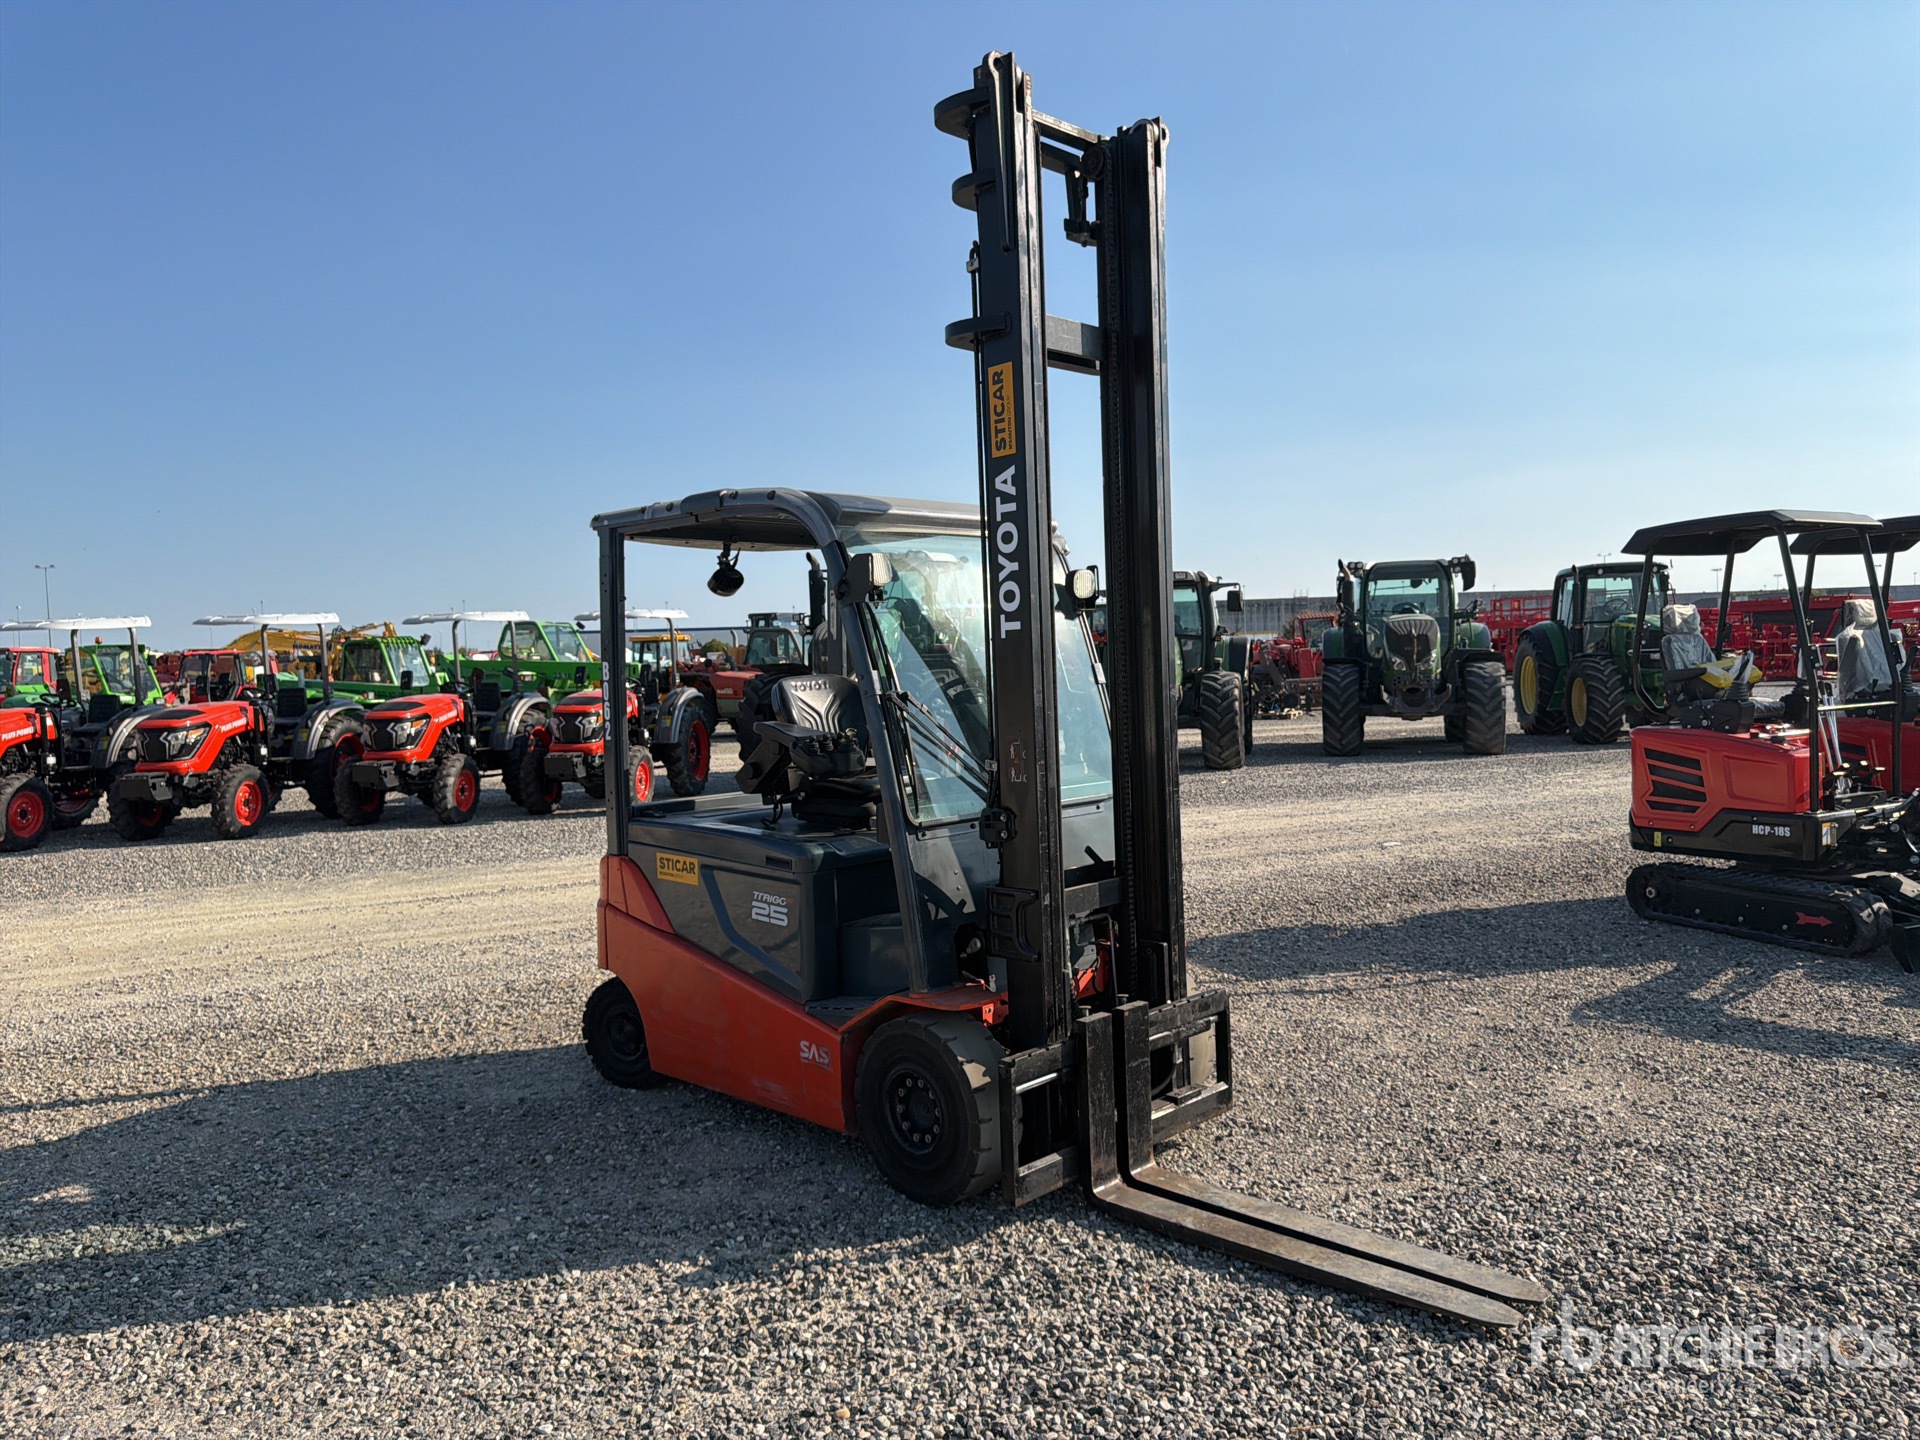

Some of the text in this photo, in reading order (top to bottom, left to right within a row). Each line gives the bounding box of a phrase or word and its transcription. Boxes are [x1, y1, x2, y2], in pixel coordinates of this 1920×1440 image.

[992, 369, 1007, 452] STICAR
[995, 464, 1021, 639] TOYOTA
[602, 661, 611, 740] B062
[1752, 824, 1791, 837] HCP-18S
[659, 856, 696, 875] STICAR
[751, 900, 789, 927] 25
[799, 1040, 830, 1065] SAS
